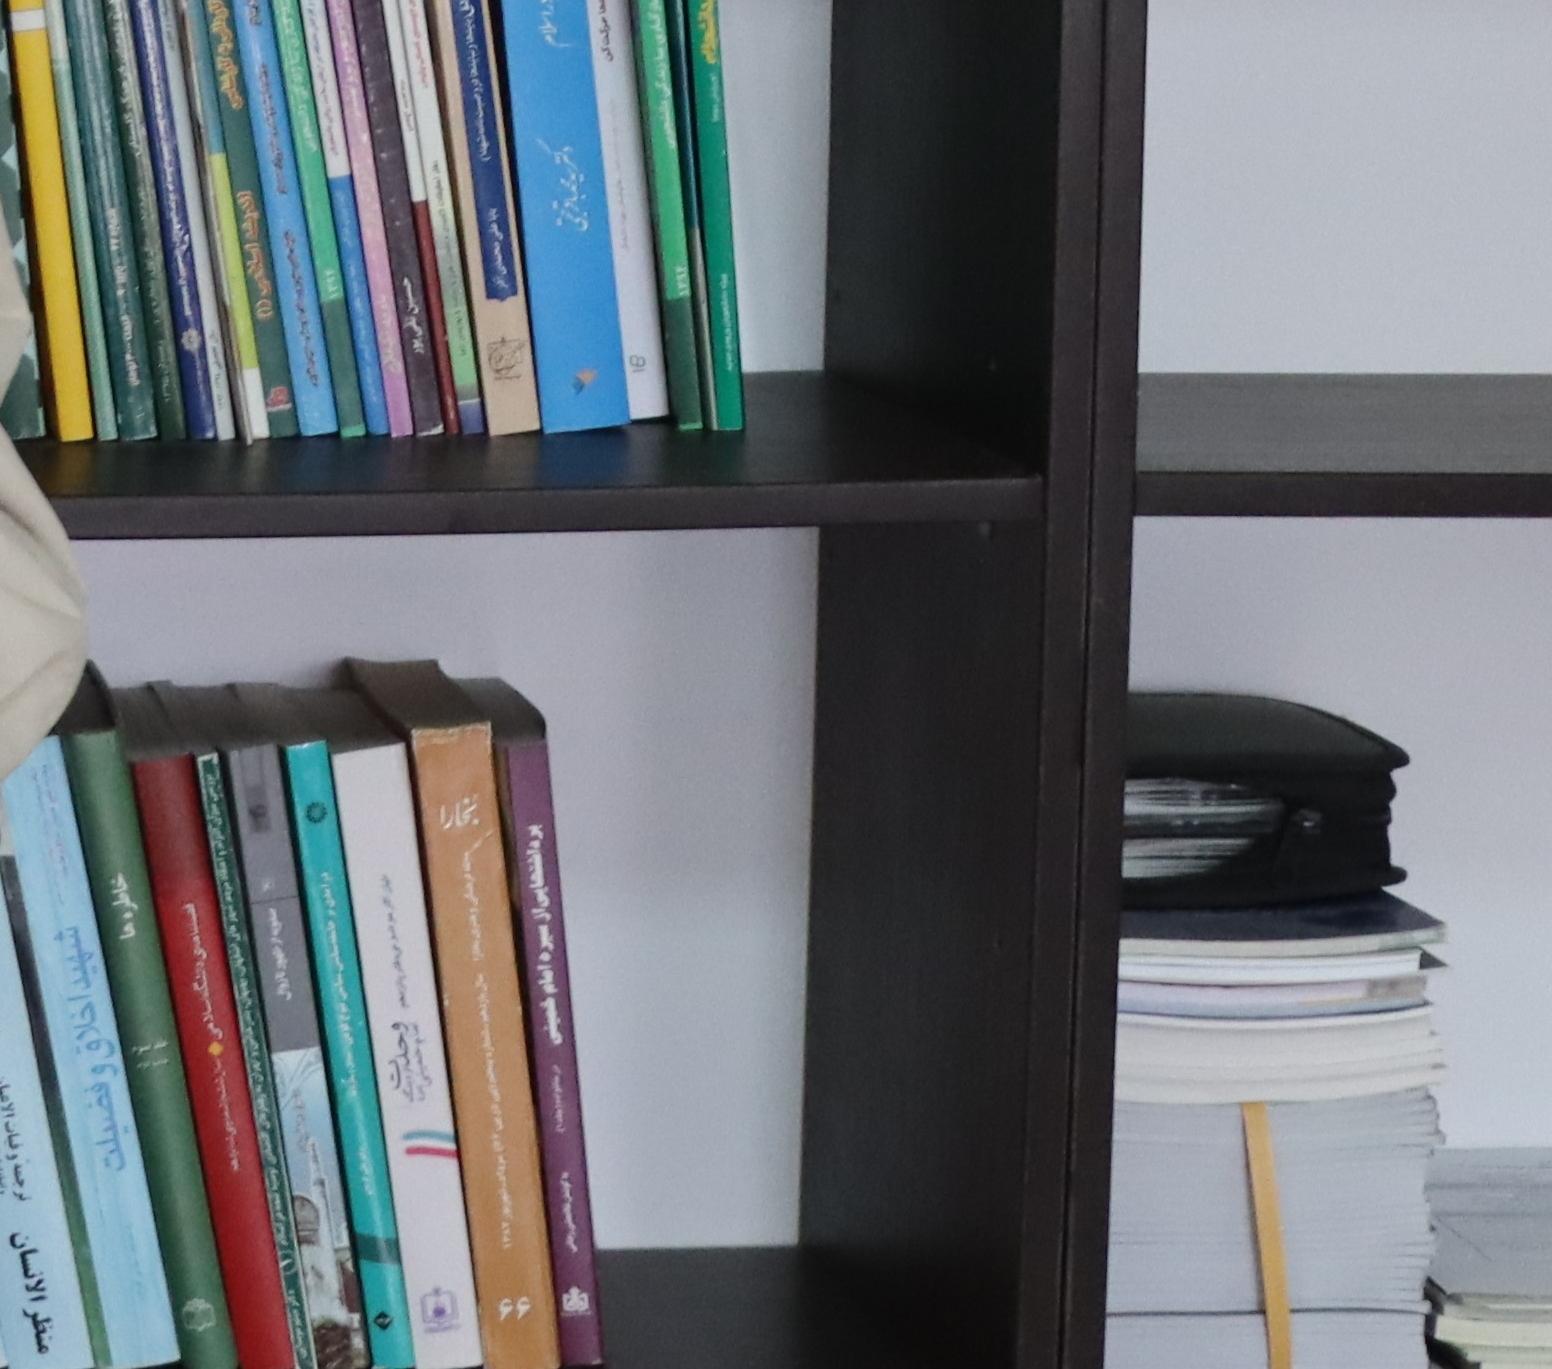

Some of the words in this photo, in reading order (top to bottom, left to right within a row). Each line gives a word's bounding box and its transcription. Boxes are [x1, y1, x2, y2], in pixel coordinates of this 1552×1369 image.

[52, 923, 99, 992] شهید
[67, 990, 116, 1062] اخلاق
[82, 1079, 131, 1174] فضیلت
[8, 1229, 47, 1304] الانسان
[22, 1304, 58, 1357] منظر
